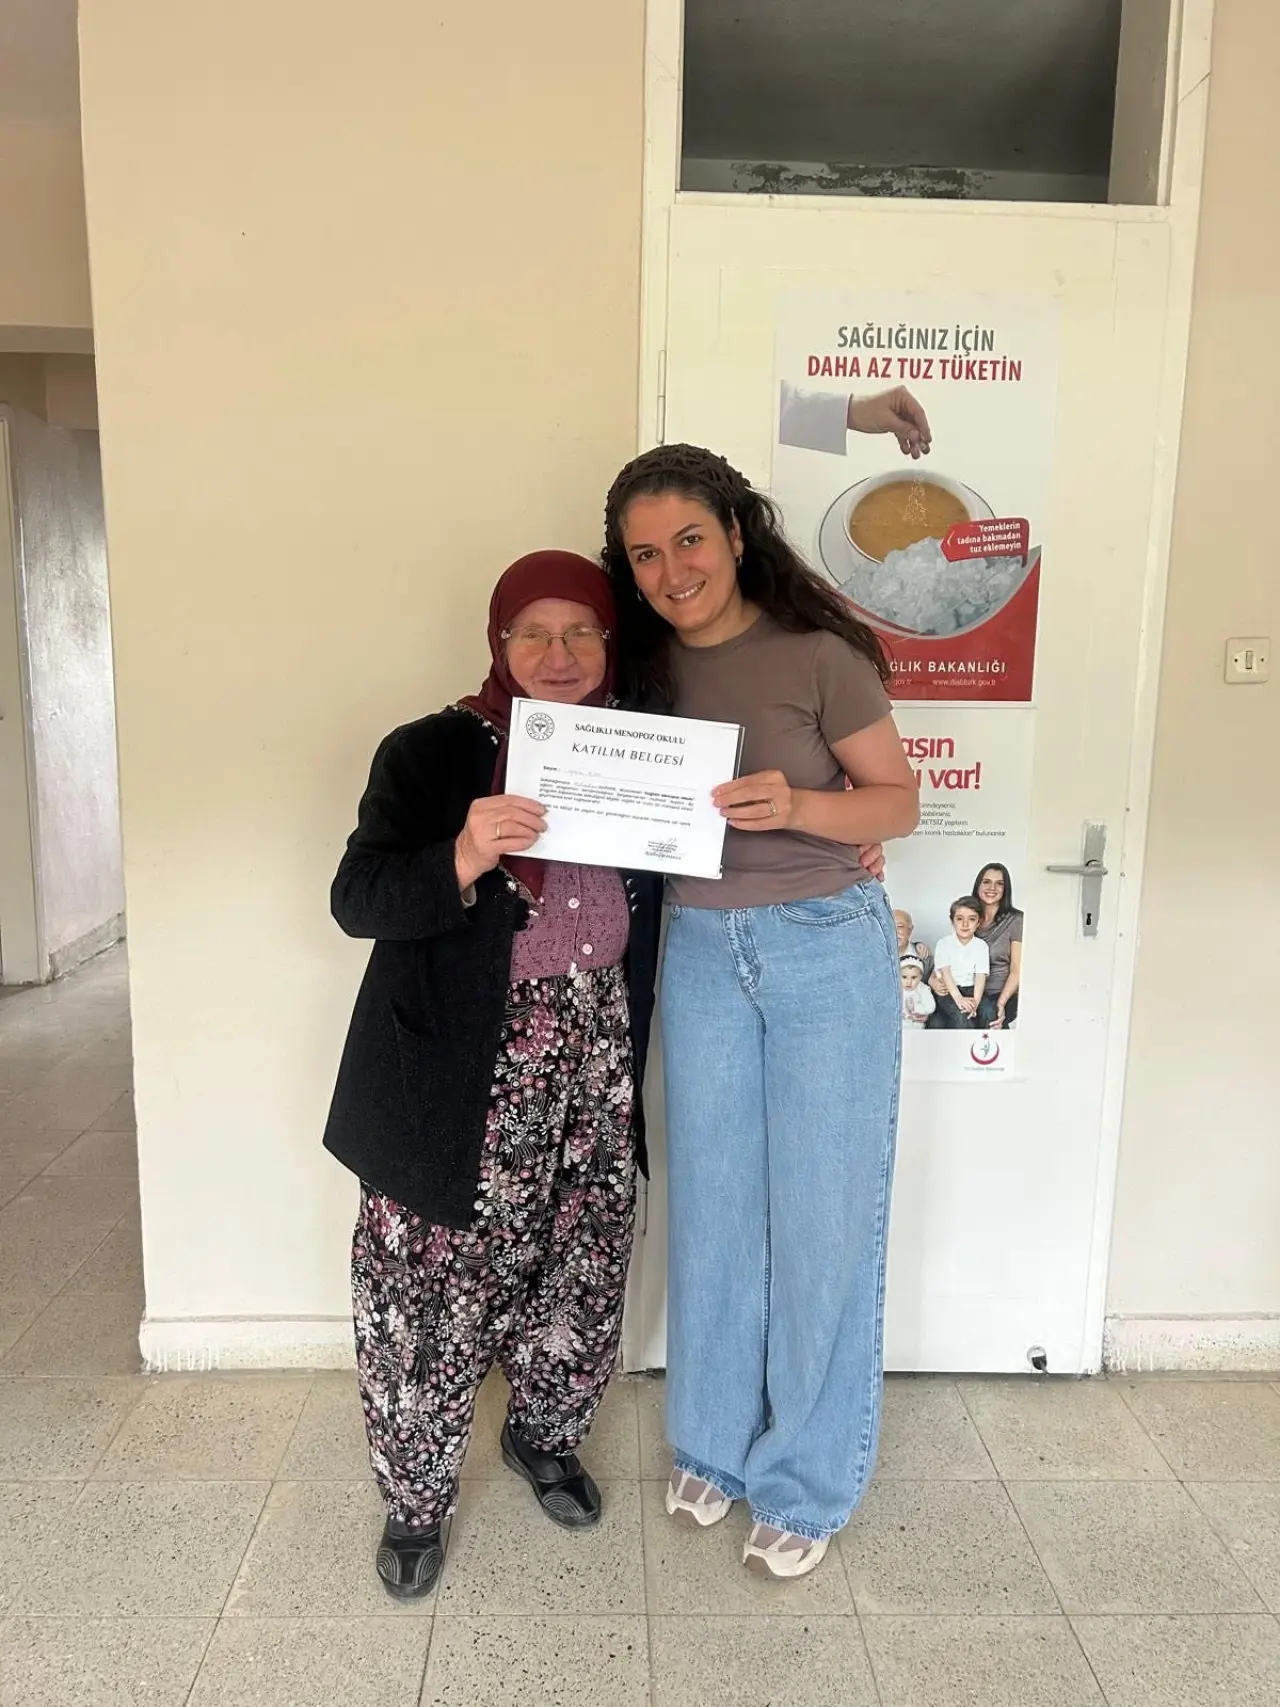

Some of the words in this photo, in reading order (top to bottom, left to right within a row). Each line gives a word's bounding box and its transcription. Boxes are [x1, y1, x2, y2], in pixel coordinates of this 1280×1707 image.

[837, 322, 949, 350] SAĞLIĞINIZ
[954, 324, 995, 356] İÇİN
[807, 355, 861, 378] DAHA
[866, 356, 893, 379] AZ
[897, 357, 934, 380] TUZ
[939, 354, 1023, 382] TÜKETİN
[957, 535, 981, 545] tadına
[982, 532, 1020, 542] bakmadan
[980, 522, 1020, 532] Yemeklerin
[970, 545, 982, 553] tuz
[983, 542, 1021, 551] eklemeyin
[927, 659, 1007, 673] BAKANLIĞI
[574, 723, 613, 735] SAĞLIKLI
[614, 729, 655, 741] MENOPOZ
[656, 734, 686, 745] OKULU
[571, 742, 626, 759] KATILIM
[629, 750, 685, 766] BELGESİ
[900, 737, 955, 764] aşın
[928, 761, 982, 790] var!
